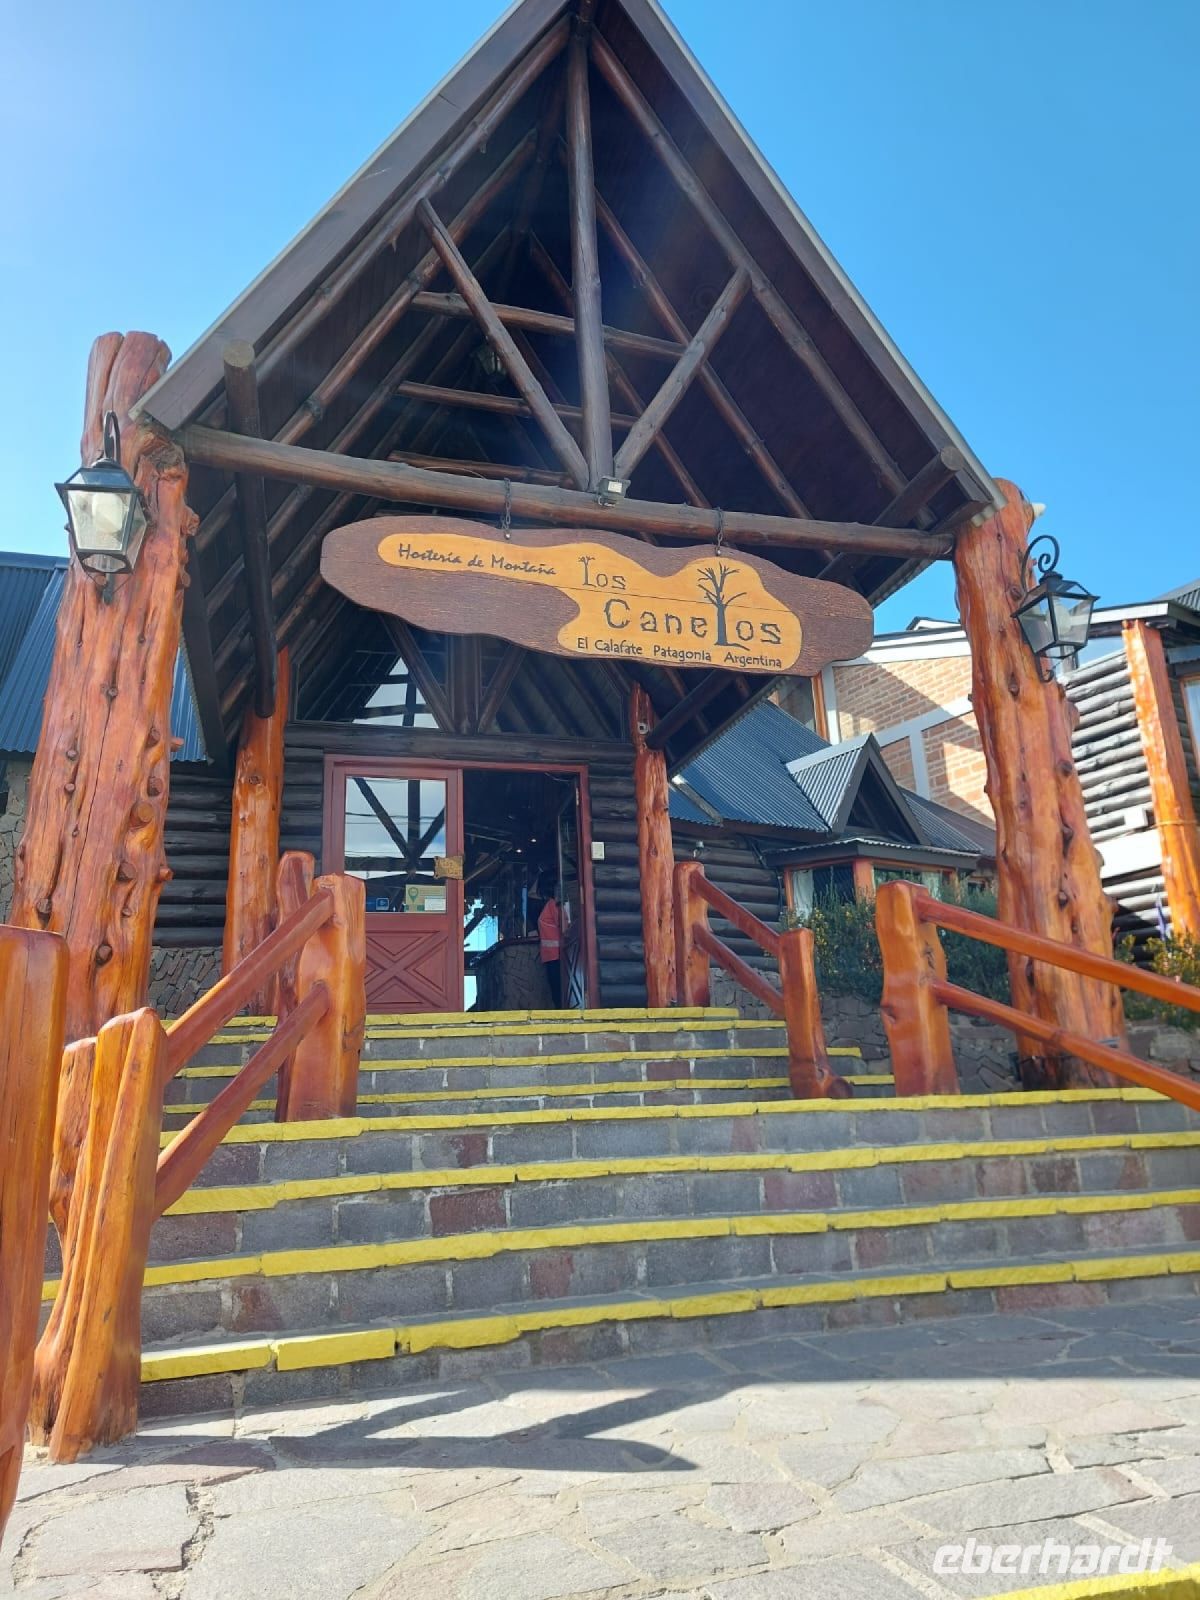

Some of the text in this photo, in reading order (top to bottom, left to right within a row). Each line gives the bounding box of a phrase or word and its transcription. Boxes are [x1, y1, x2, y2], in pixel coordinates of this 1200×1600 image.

[467, 555, 484, 568] de
[491, 554, 557, 575] Montaña
[578, 556, 627, 590] Los
[577, 637, 782, 668] El Calafate Patagonia Argentina
